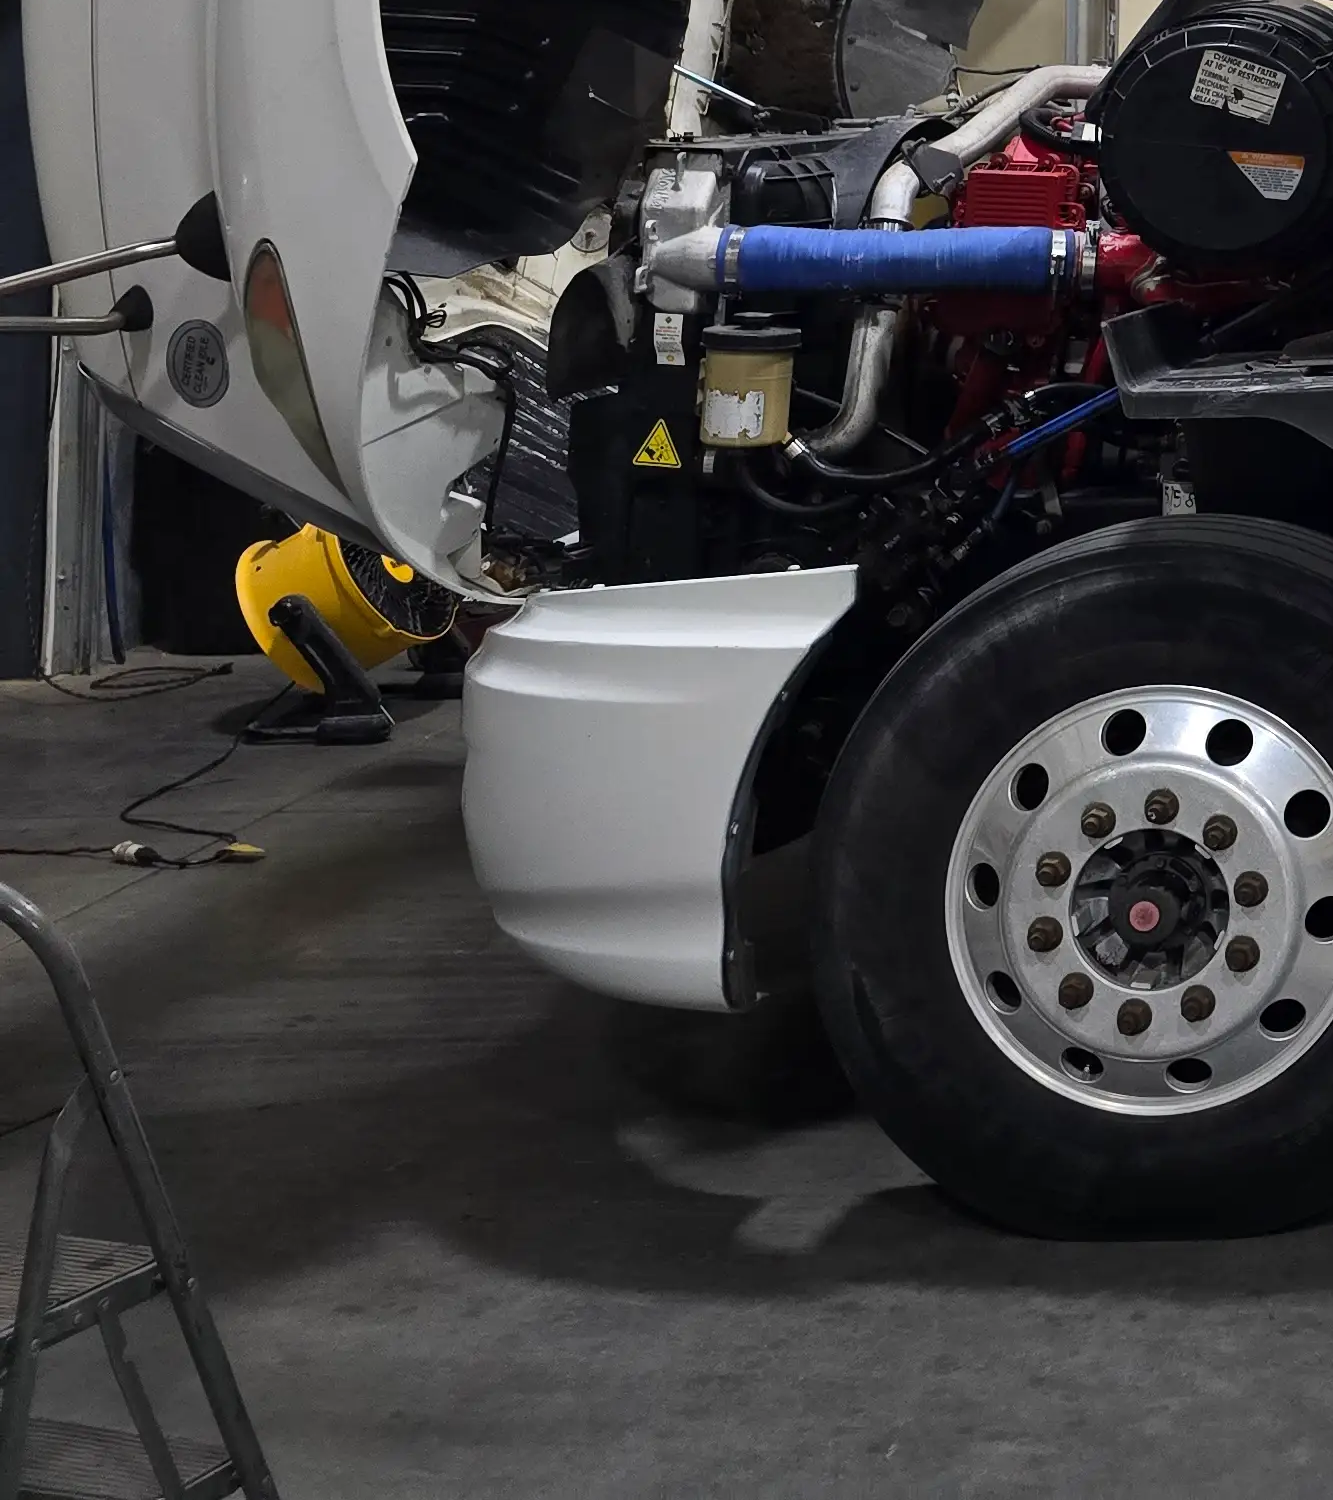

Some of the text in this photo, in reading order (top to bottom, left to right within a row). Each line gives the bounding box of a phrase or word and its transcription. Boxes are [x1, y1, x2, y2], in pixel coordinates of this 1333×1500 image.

[1200, 68, 1230, 84] TERMINAL
[1204, 59, 1214, 67] AT
[1227, 65, 1237, 75] OF
[1237, 70, 1281, 89] RESTRICTION
[1213, 52, 1278, 79] CHANGE AIR FILTER
[1195, 86, 1211, 96] DATE
[182, 336, 196, 386] CERTIFIED
[193, 359, 207, 394] CLEAN
